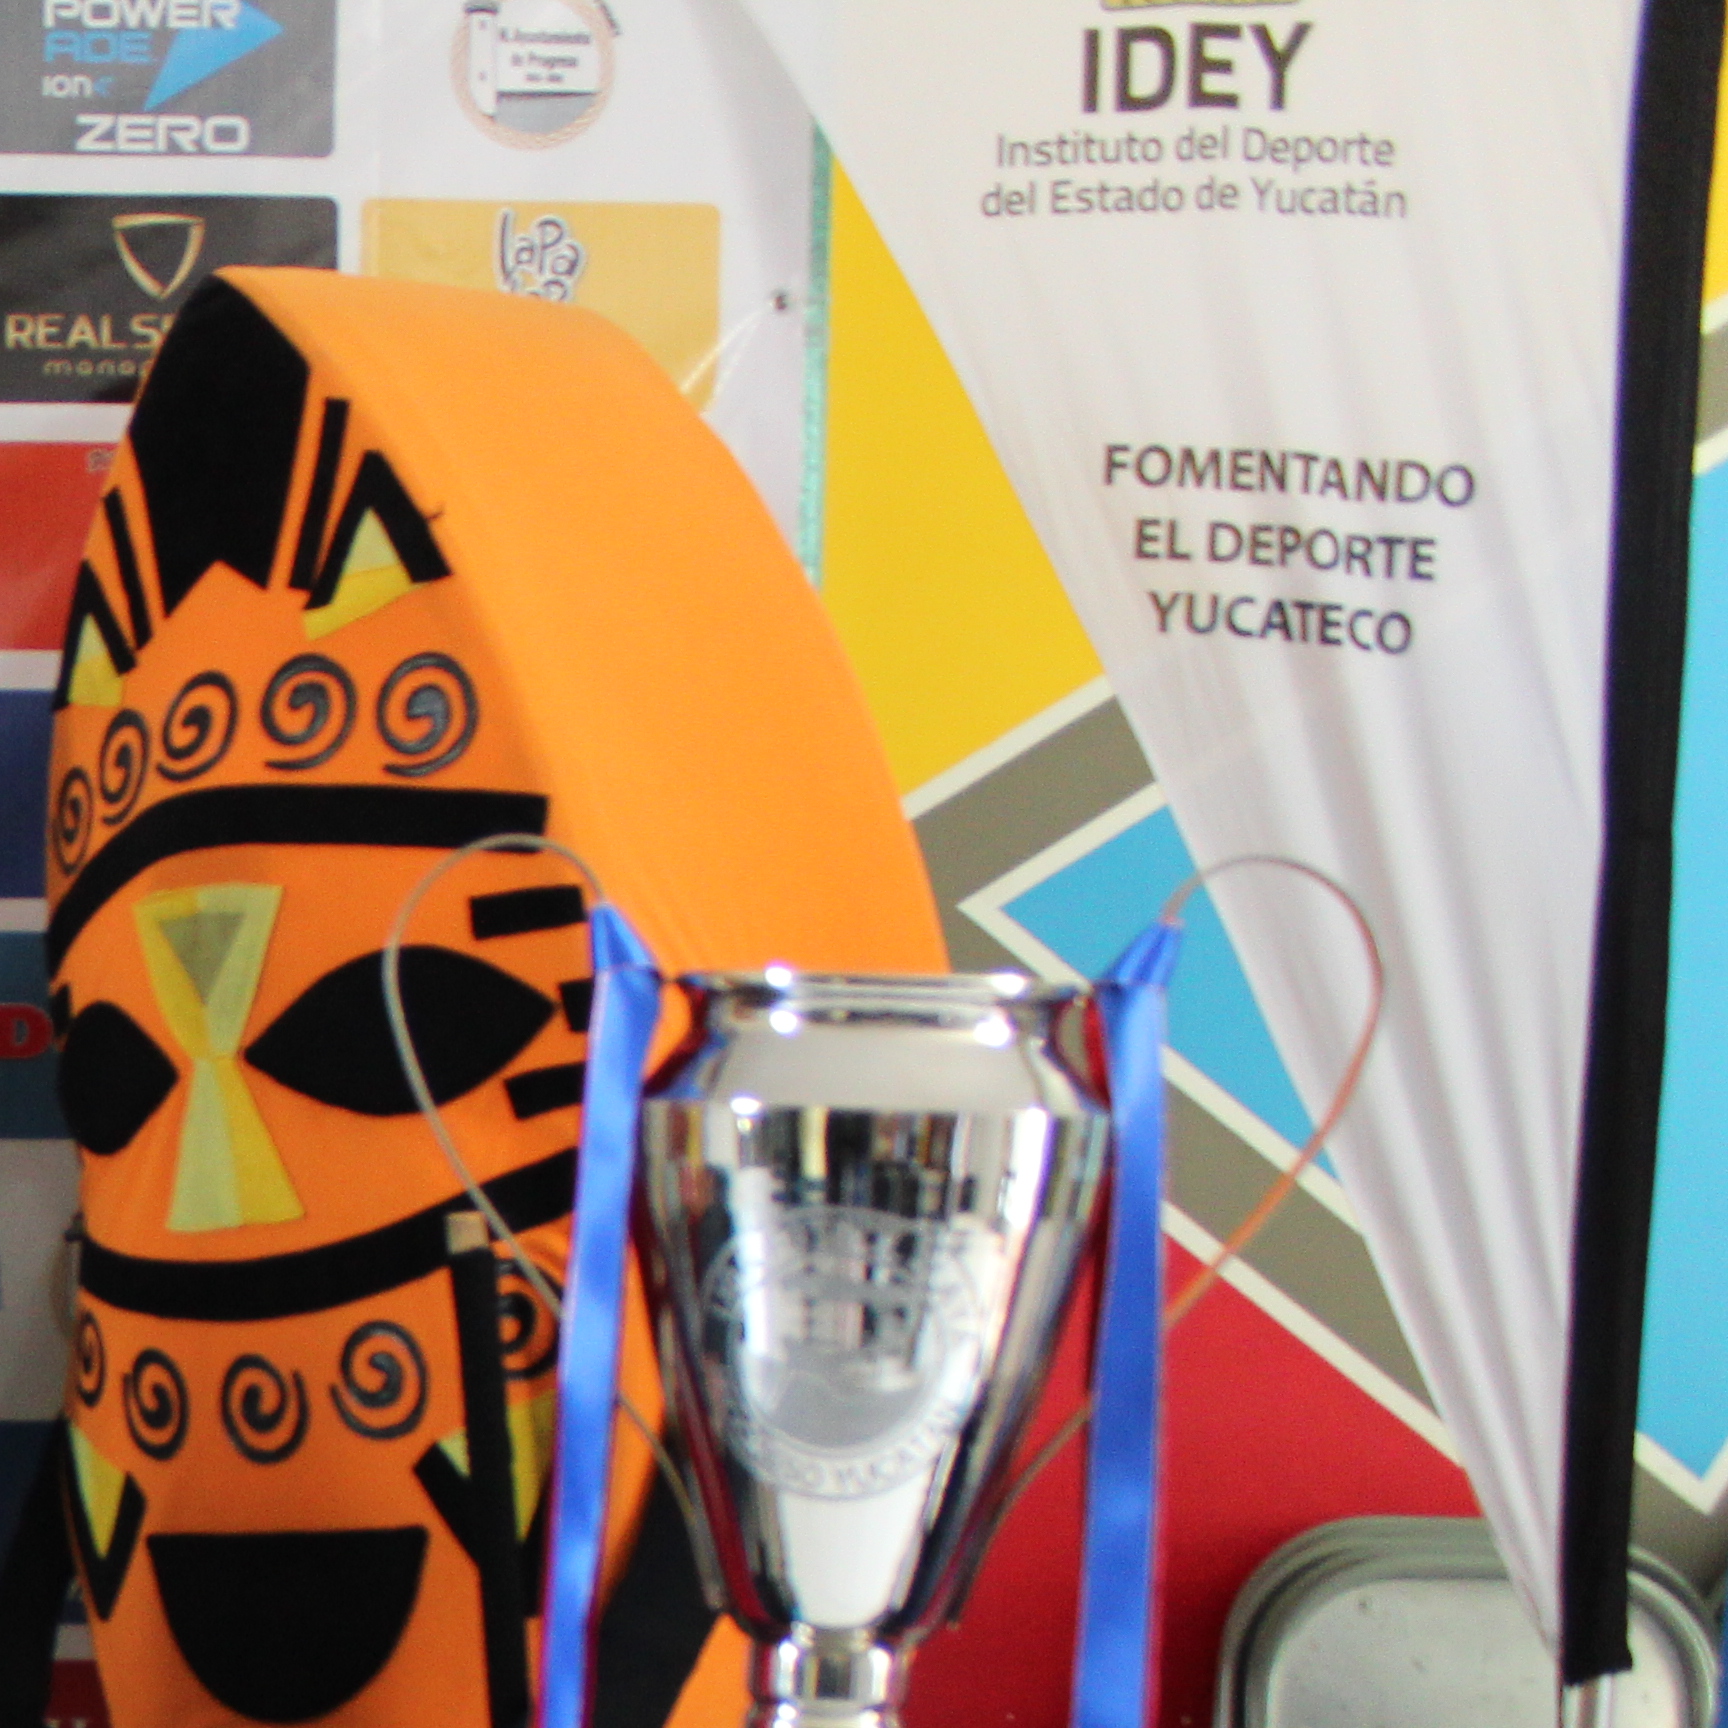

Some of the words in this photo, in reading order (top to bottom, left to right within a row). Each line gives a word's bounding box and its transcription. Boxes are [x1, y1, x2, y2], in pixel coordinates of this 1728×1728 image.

[43, 0, 242, 30] POWER
[1080, 21, 1315, 115] IDEY
[74, 113, 251, 153] ZERO
[996, 131, 1165, 169] Instituto
[1176, 126, 1230, 164] del
[1241, 127, 1396, 173] Deporte
[981, 181, 1037, 219] del
[1049, 179, 1186, 217] Estado
[1194, 175, 1240, 211] de
[1252, 178, 1408, 219] Yucatán
[1101, 442, 1476, 509] FOMENTANDO
[1133, 517, 1191, 562] EL
[1208, 520, 1438, 583] DEPORTE
[1147, 589, 1414, 656] YUCATECO
